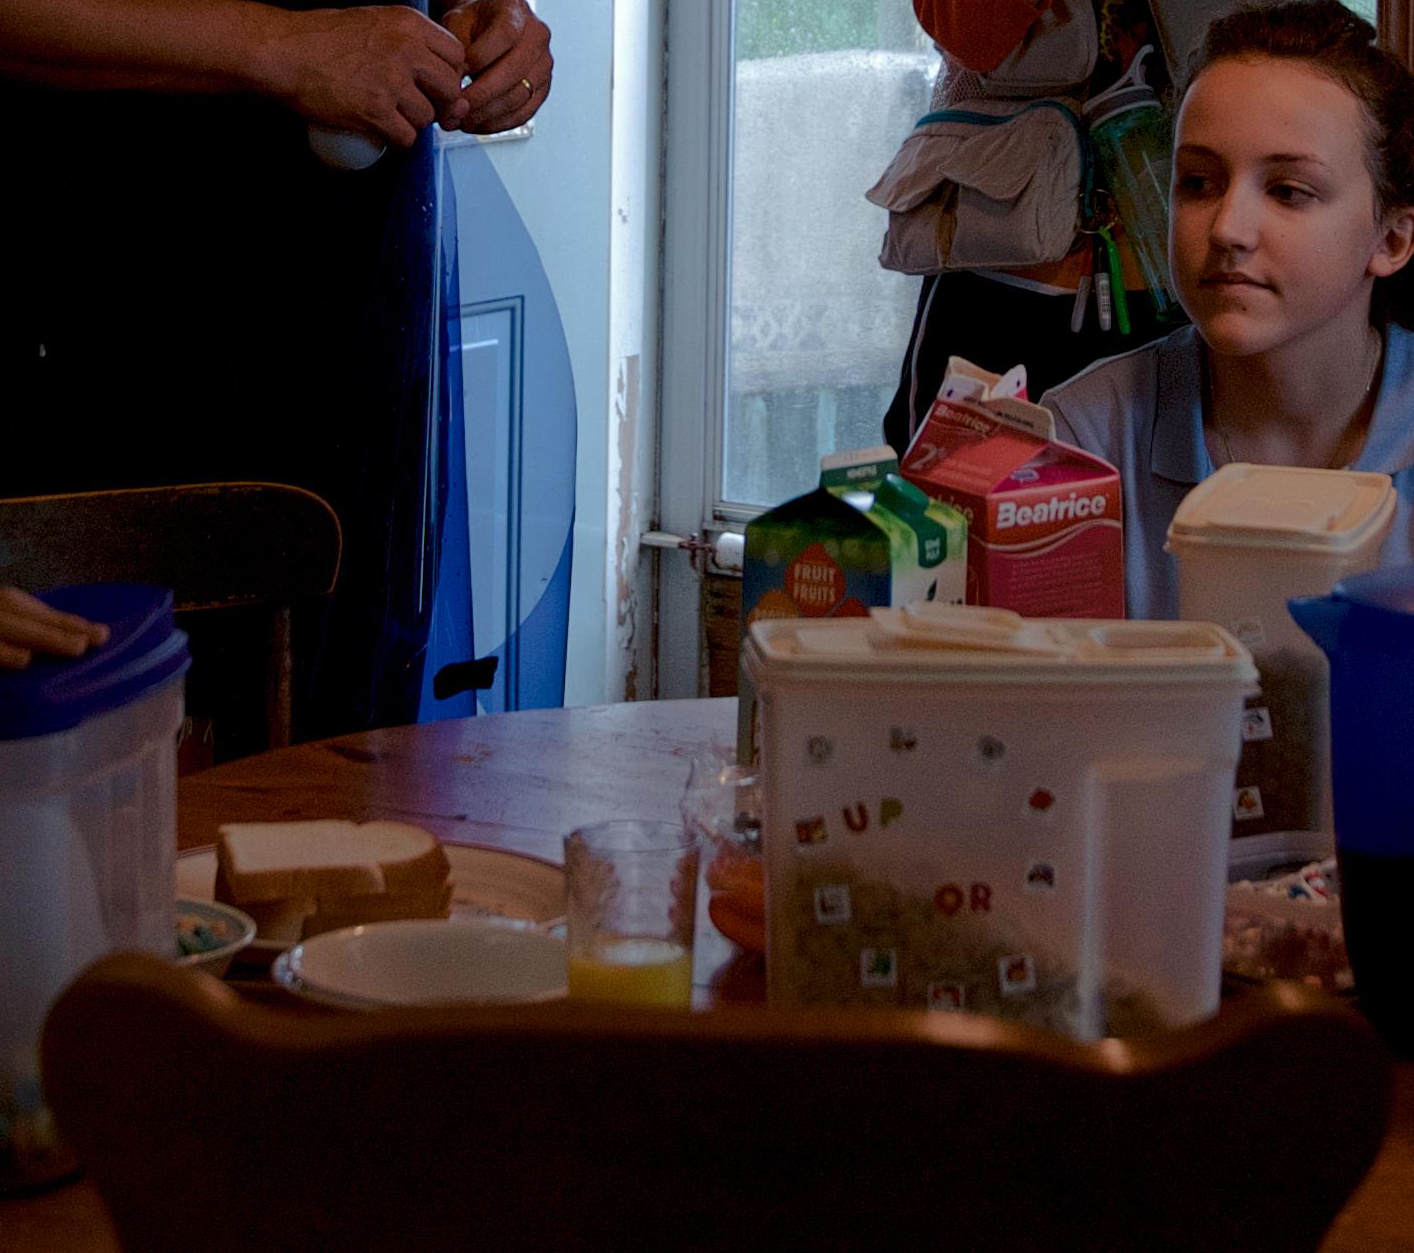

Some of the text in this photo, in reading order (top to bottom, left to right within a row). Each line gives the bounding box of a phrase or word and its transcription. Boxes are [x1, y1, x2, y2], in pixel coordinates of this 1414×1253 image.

[934, 403, 990, 434] Beatrice
[995, 492, 1107, 530] Beatrice
[793, 562, 837, 584] FRUIT
[793, 582, 837, 604] FRUITS
[842, 797, 904, 833] UP
